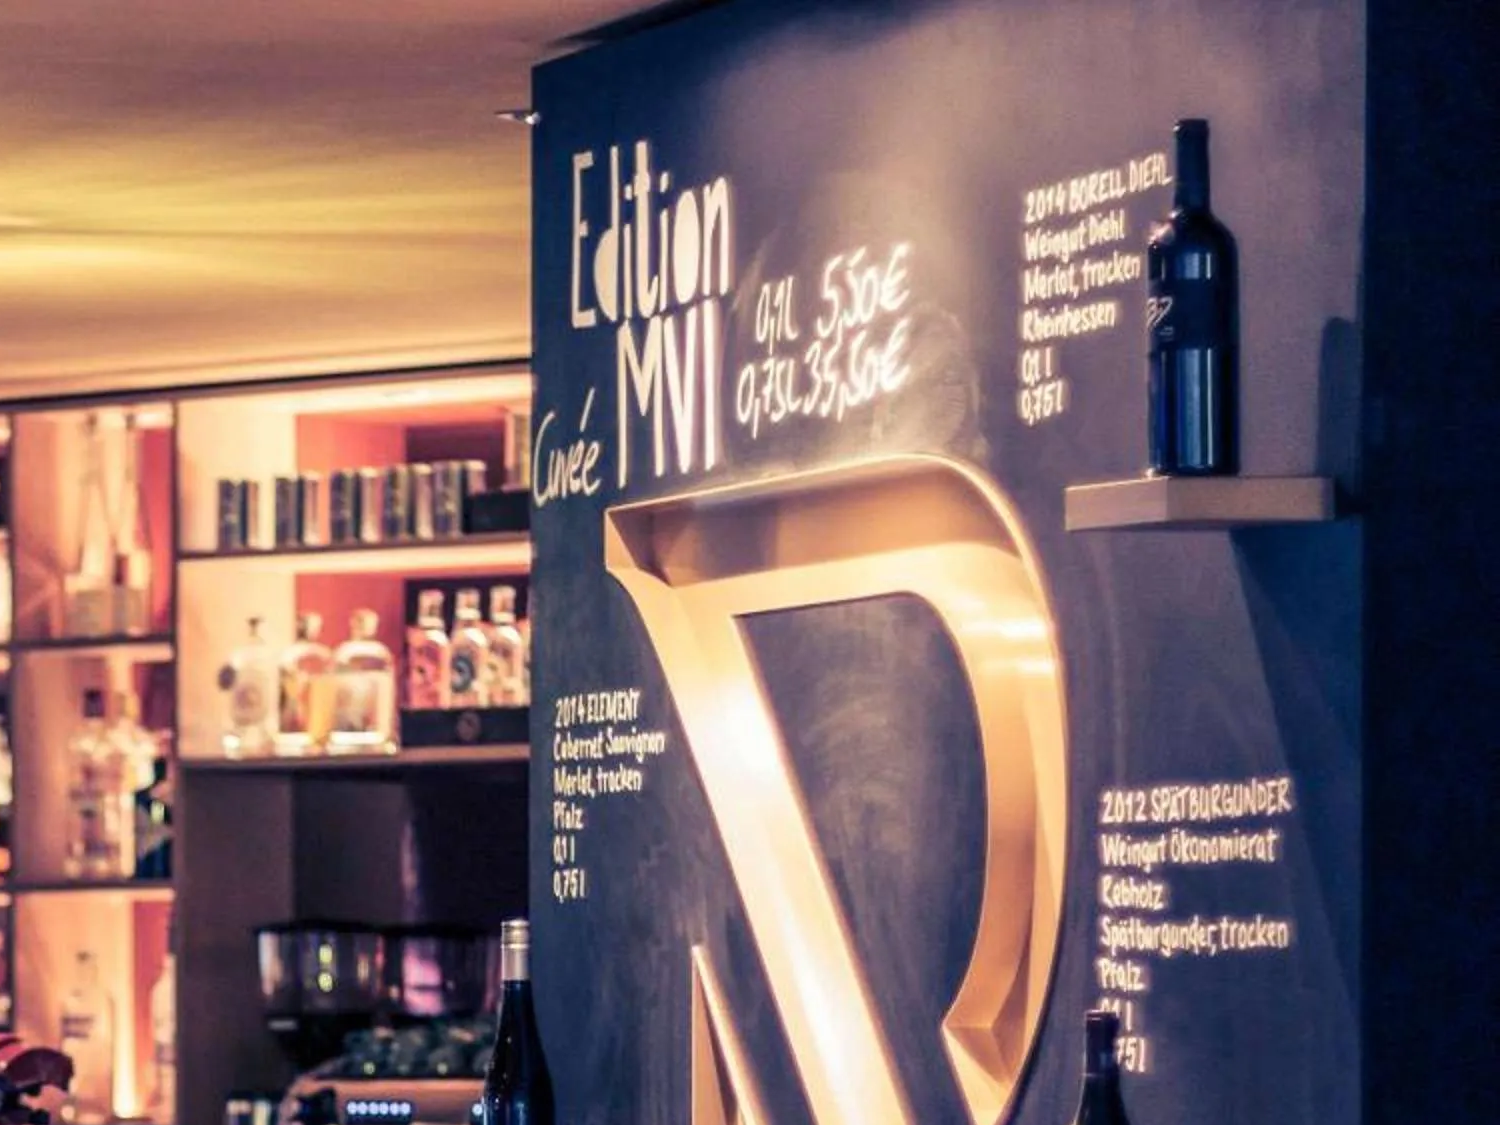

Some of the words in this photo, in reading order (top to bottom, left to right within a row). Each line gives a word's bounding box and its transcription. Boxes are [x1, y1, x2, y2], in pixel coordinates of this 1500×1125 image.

[1025, 190, 1065, 223] 2014
[1129, 152, 1173, 192] DIEHL
[571, 140, 731, 329] Edition
[1024, 220, 1087, 263] Weingut
[1088, 209, 1125, 245] Diehl
[1082, 250, 1141, 291] trocken
[1023, 301, 1117, 342] Rheinhessen
[616, 298, 717, 489] MVI
[533, 387, 602, 508] Cuvée
[555, 694, 584, 727] 2014
[586, 688, 641, 724] ELEMENT
[553, 731, 603, 760] Cabernet
[606, 726, 665, 763] Sauvignon
[597, 762, 642, 793] trocken
[553, 801, 584, 830] Pfalz
[1102, 789, 1146, 823] 2012
[1150, 777, 1292, 823] SPÄTBURGUNDER
[1101, 832, 1167, 872] Weingut
[1171, 827, 1279, 864] Ökonomierat
[1101, 874, 1164, 910] Rebholz
[1220, 913, 1289, 949] trocken
[1097, 958, 1145, 992] Pfalz
